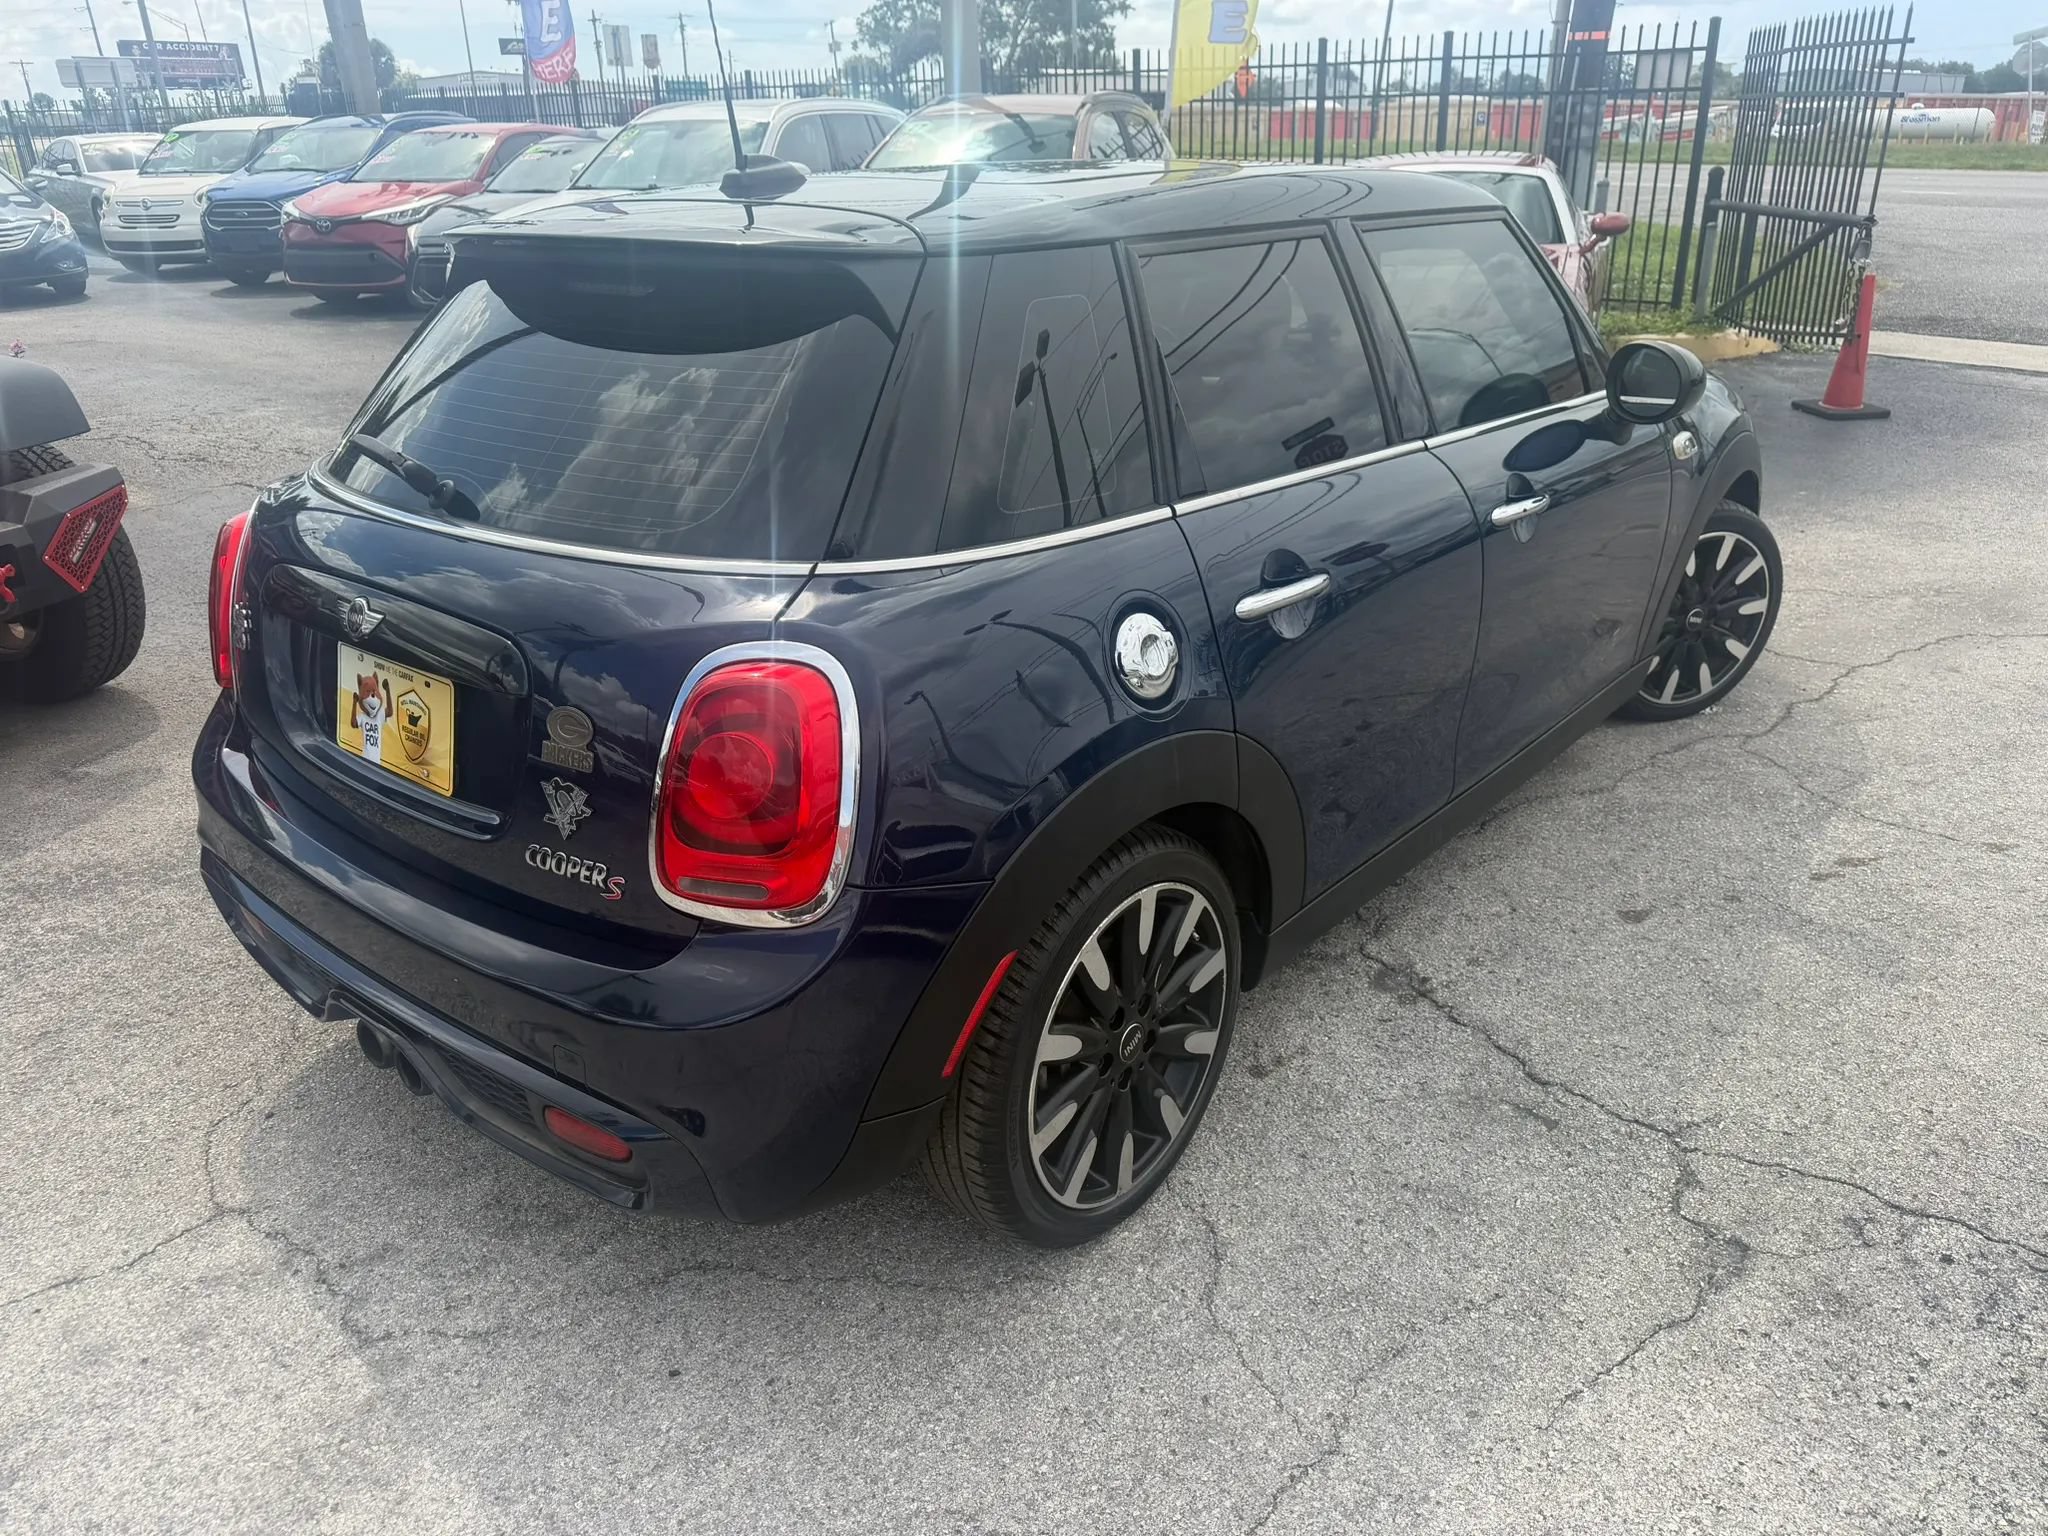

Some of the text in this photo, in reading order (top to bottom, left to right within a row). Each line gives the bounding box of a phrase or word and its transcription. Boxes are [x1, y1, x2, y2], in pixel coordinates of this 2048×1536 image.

[143, 43, 163, 51] CR
[364, 721, 379, 735] CAR
[365, 733, 379, 748] FOX
[542, 742, 593, 772] PACKERS
[1124, 1030, 1142, 1056] MINI
